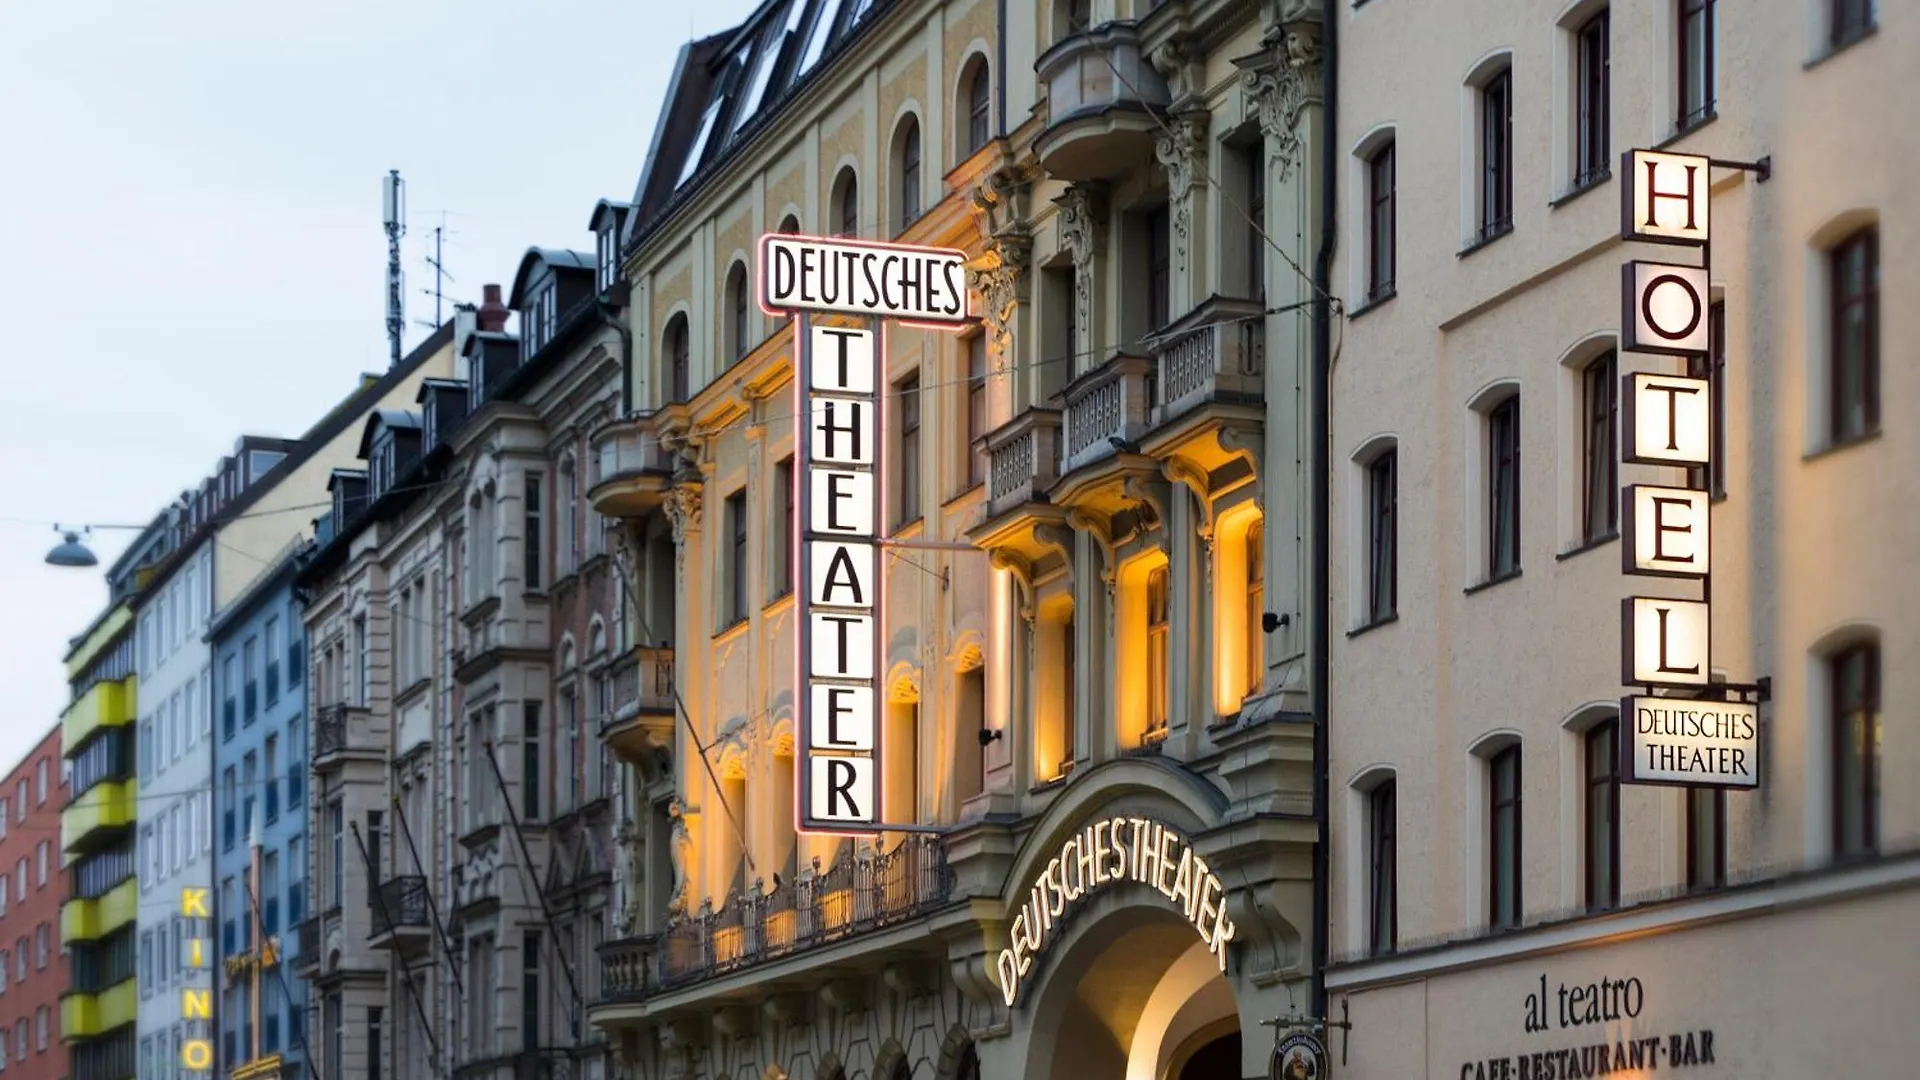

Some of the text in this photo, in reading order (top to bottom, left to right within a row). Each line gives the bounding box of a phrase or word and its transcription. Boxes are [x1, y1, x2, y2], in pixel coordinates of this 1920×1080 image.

[775, 246, 961, 315] DEUTSCHES
[1641, 160, 1702, 673] HOTEL
[817, 331, 863, 818] THEATER
[1638, 708, 1754, 740] DEUTSCHES
[1646, 744, 1748, 776] THEATER
[182, 886, 213, 1070] KINO
[1525, 973, 1644, 1033] al teatro
